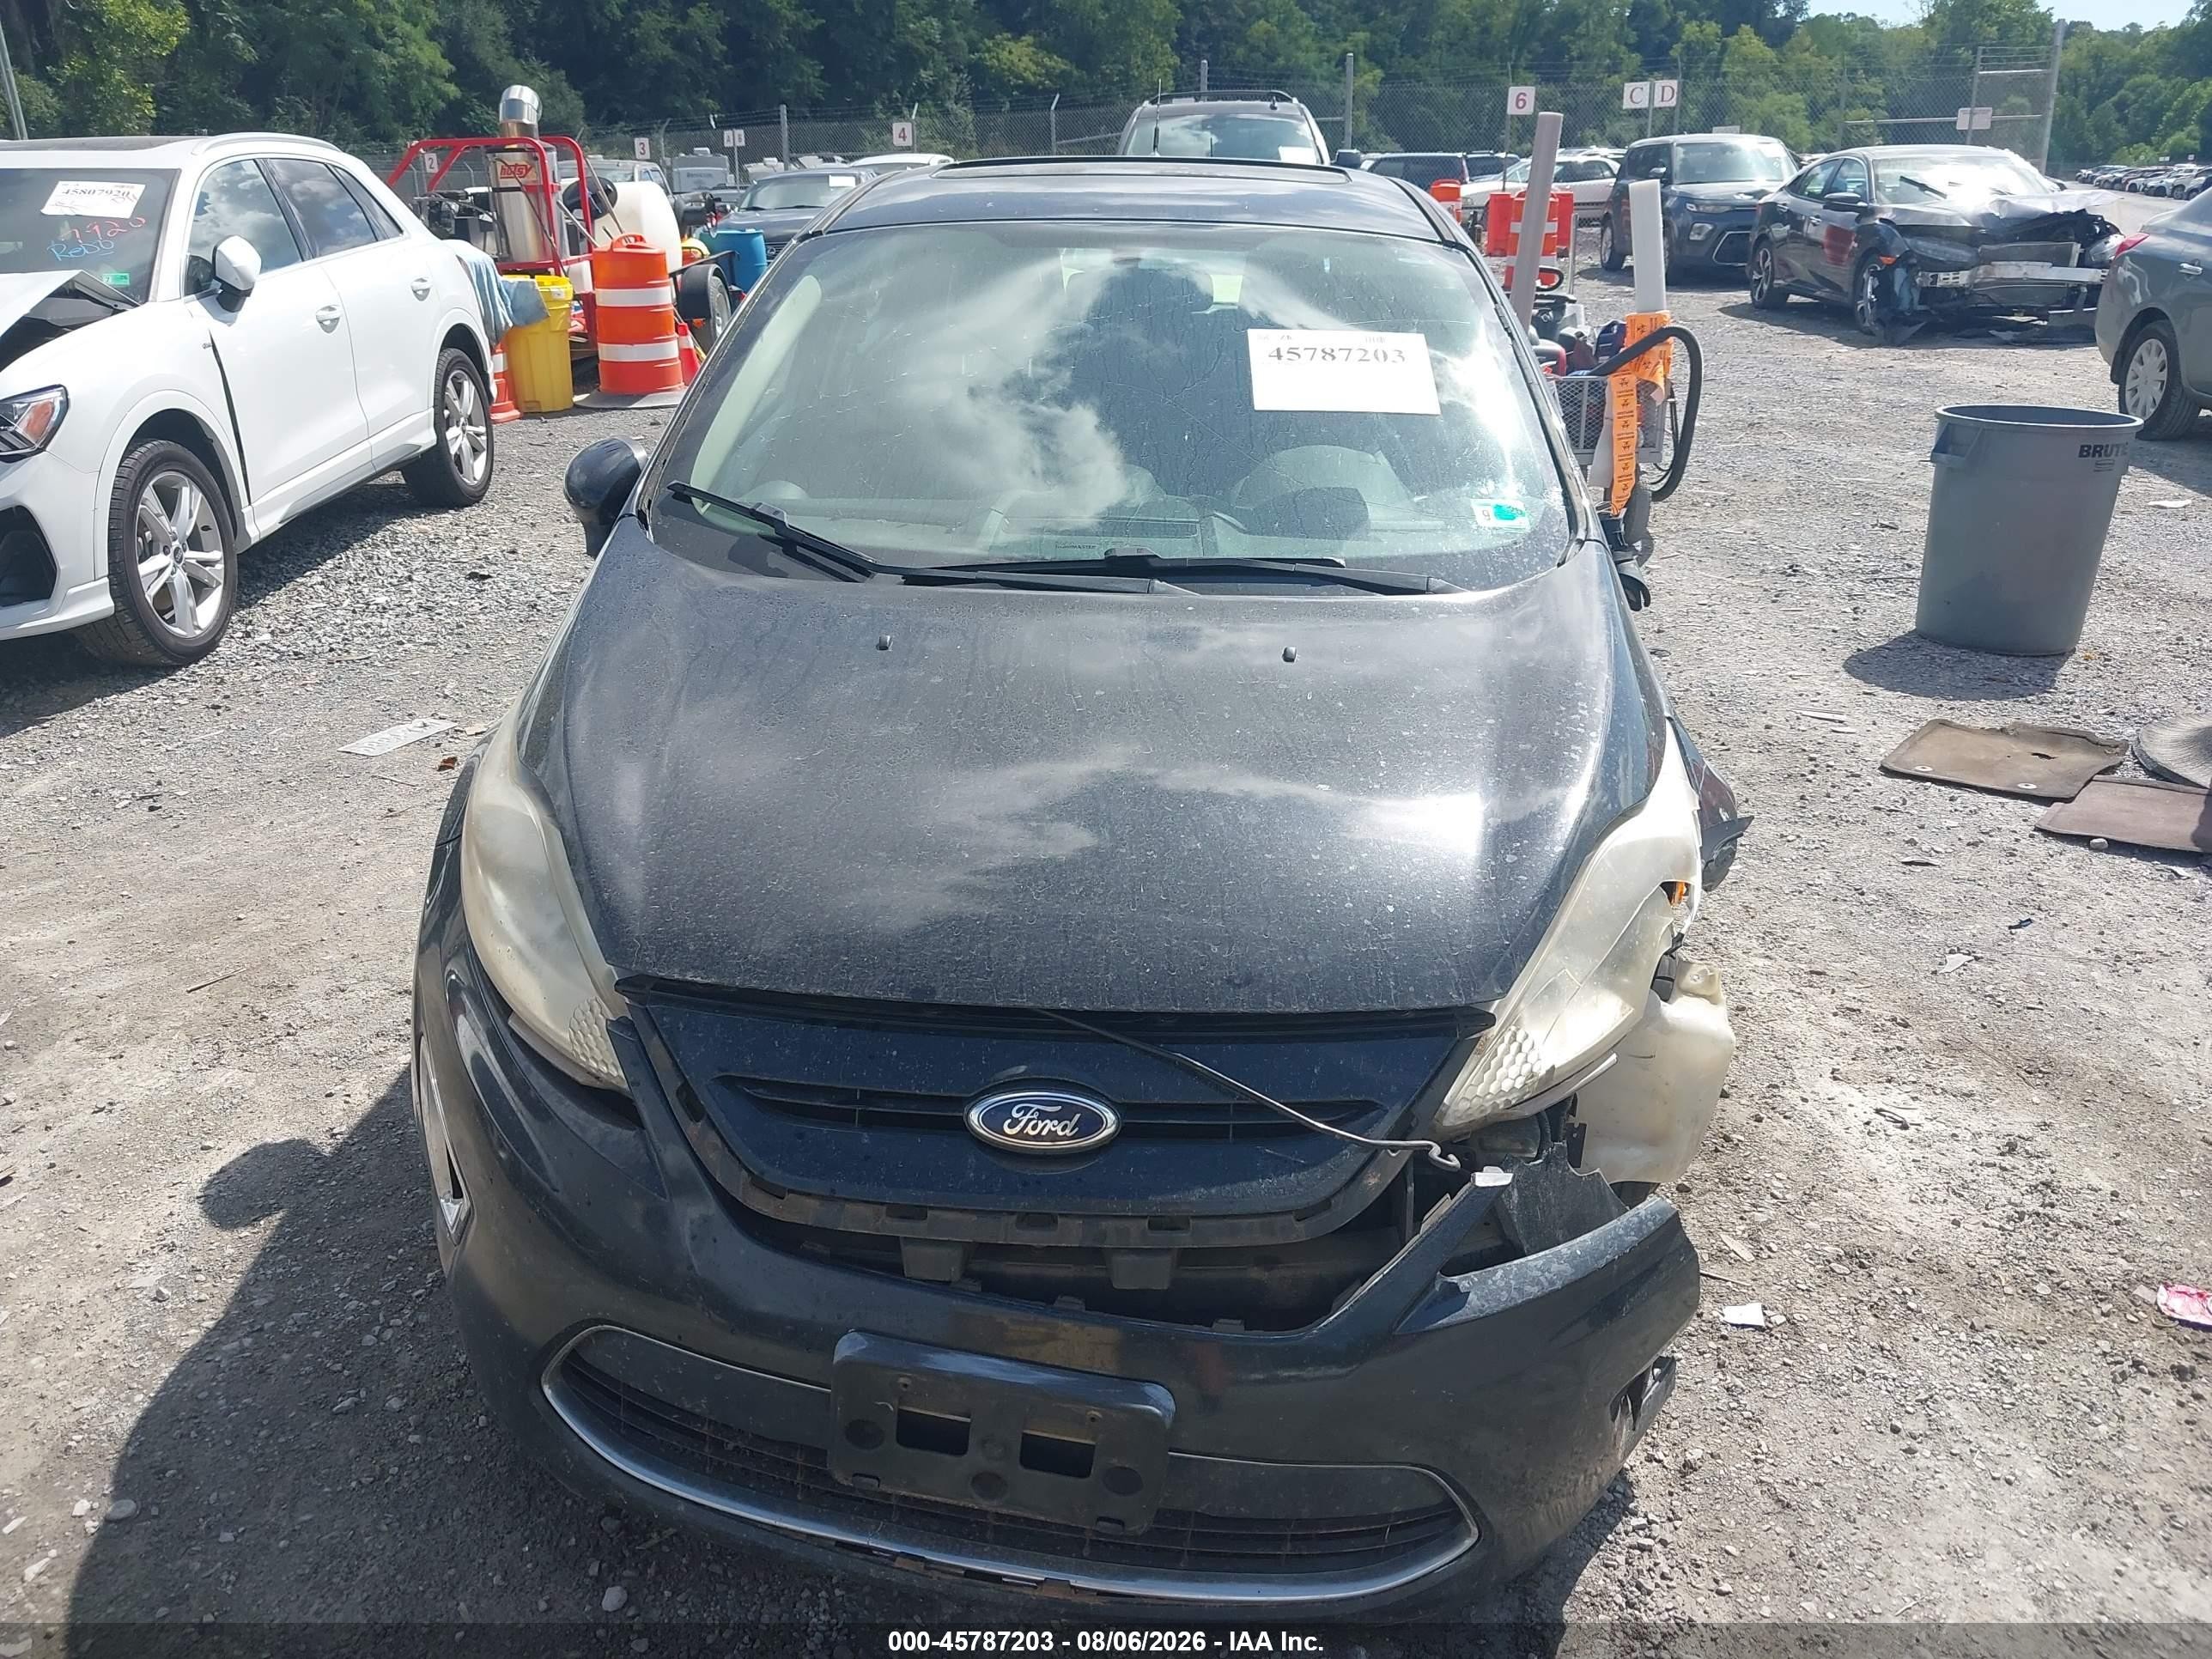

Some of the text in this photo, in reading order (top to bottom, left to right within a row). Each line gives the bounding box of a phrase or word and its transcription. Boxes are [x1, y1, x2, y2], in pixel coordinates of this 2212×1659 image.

[1515, 92, 1527, 109] 6
[1630, 85, 1674, 104] C D
[898, 127, 907, 142] 4
[639, 142, 647, 155] 3
[428, 157, 434, 170] 2
[1268, 347, 1406, 363] 45787203
[1003, 1103, 1081, 1137] Ford
